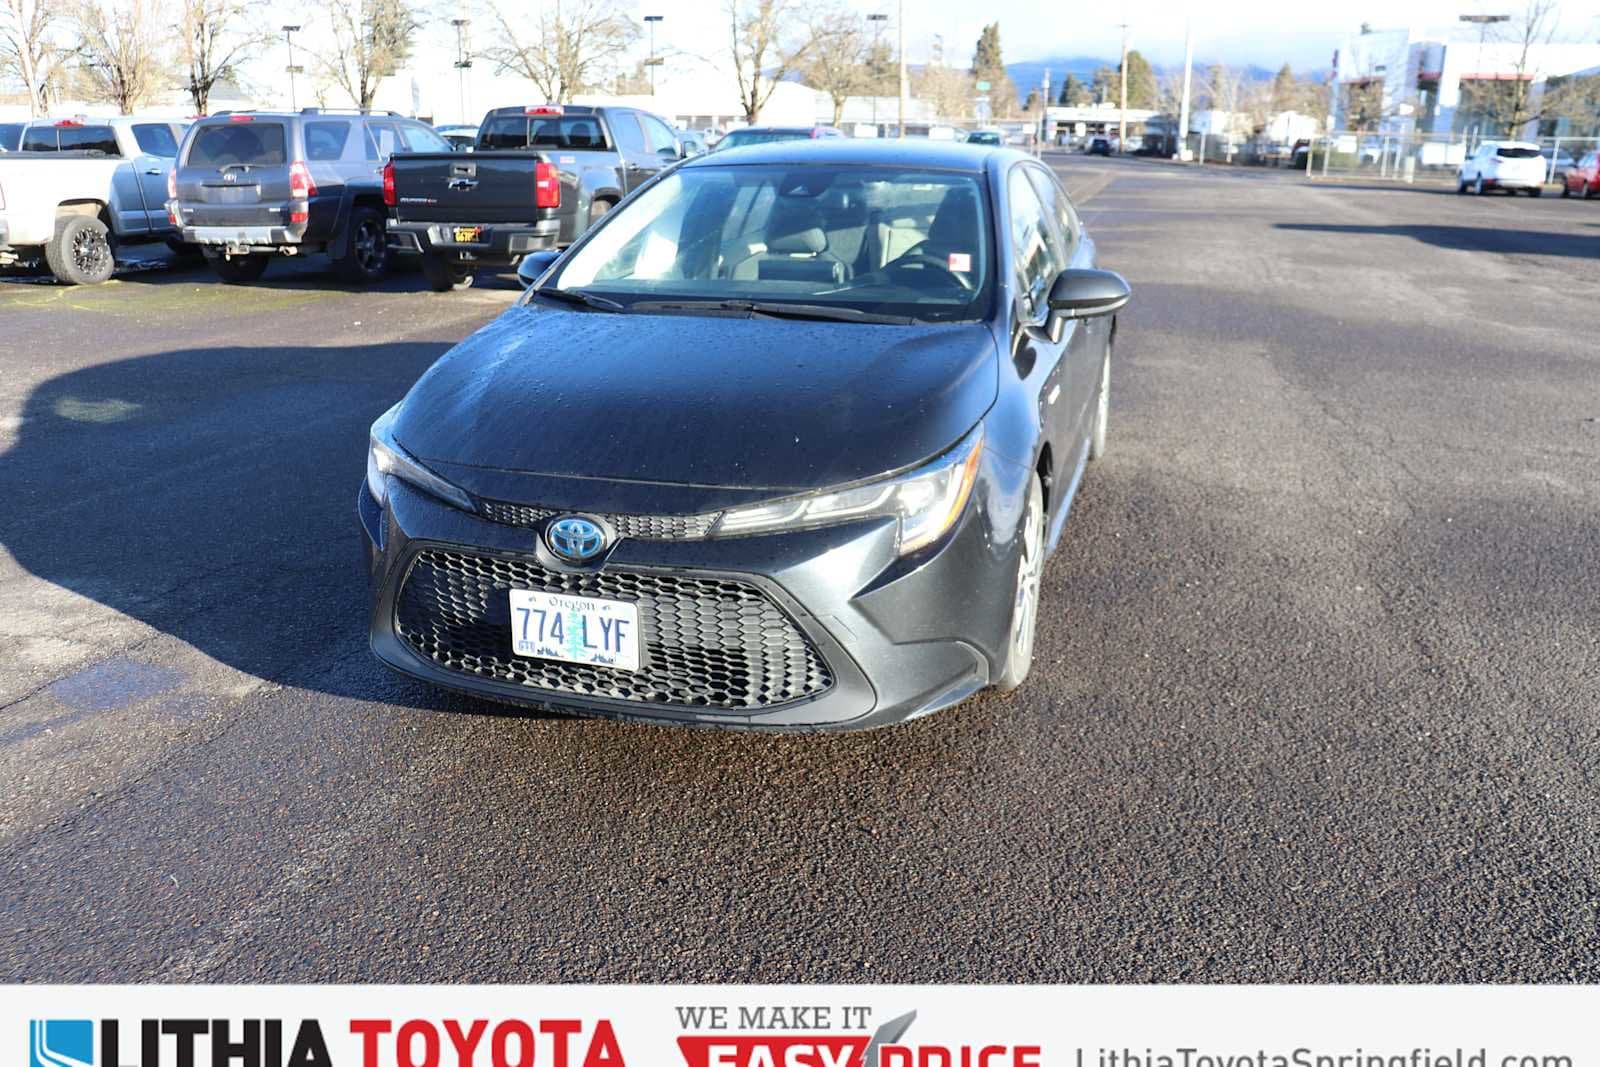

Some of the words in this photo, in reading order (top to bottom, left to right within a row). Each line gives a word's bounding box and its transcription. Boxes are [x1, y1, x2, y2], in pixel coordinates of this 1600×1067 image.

[548, 596, 597, 612] Oregon
[516, 607, 565, 645] 774
[582, 614, 630, 653] LYF
